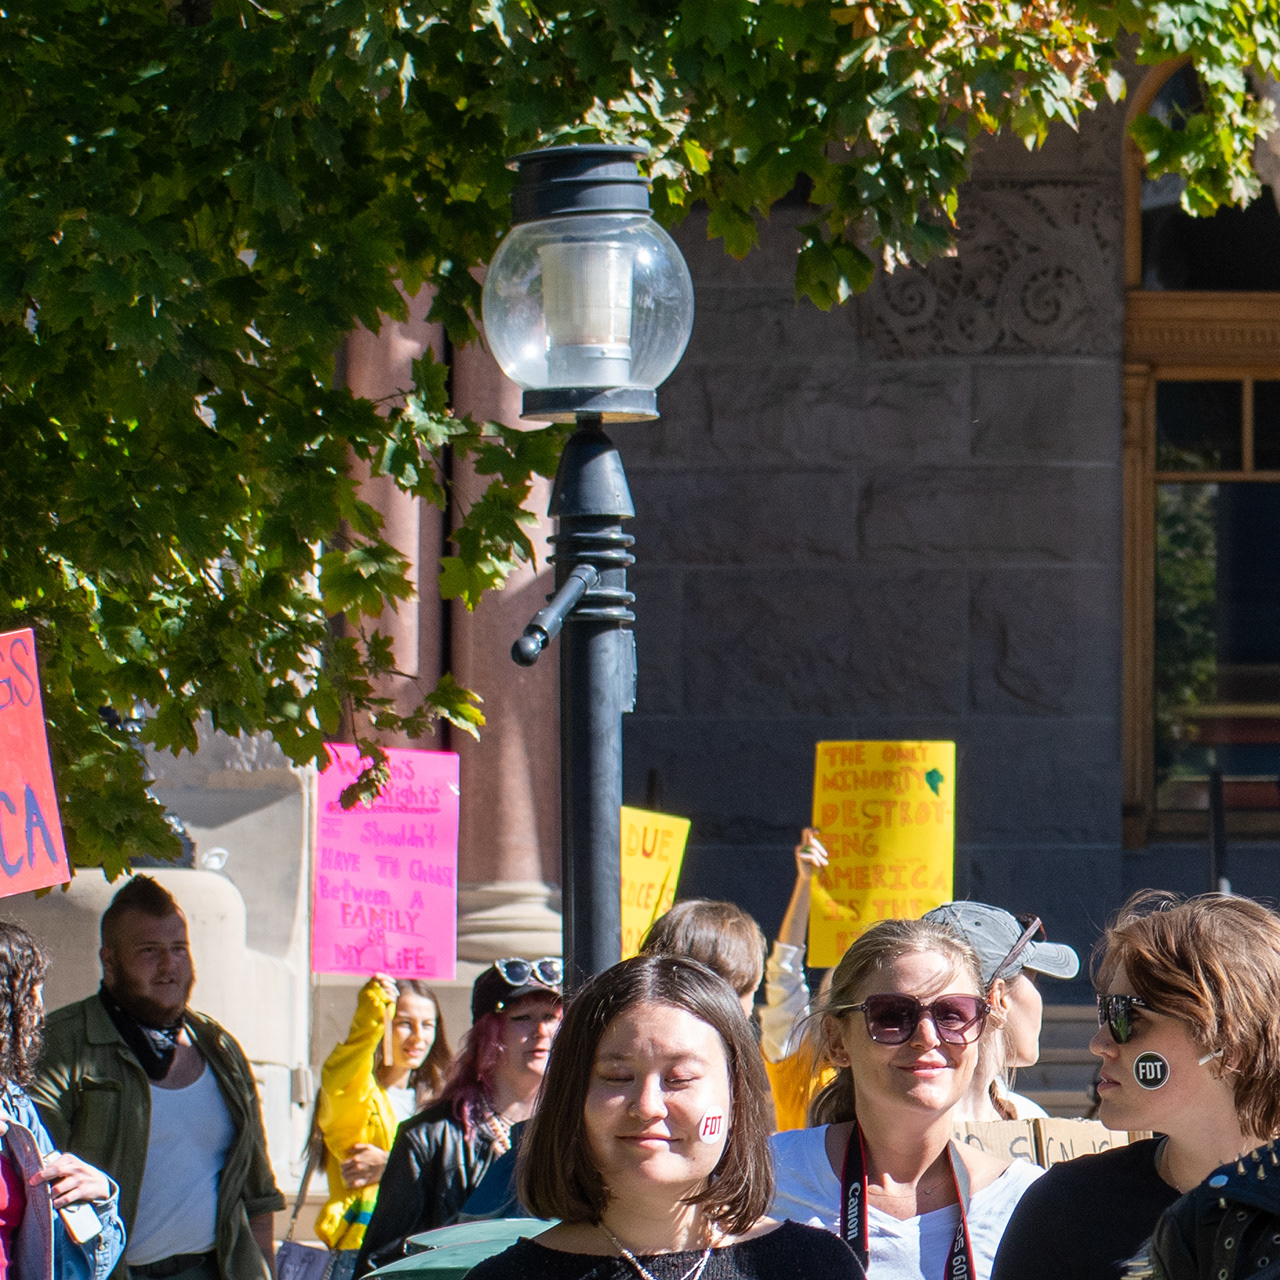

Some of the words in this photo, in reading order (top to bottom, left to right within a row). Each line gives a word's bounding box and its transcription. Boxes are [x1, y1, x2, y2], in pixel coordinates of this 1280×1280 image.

[824, 744, 866, 768] THE
[625, 824, 673, 862] DUE
[321, 848, 361, 873] HAVE
[817, 864, 948, 891] AMERICA
[824, 899, 861, 922] IS
[334, 943, 367, 967] MY
[1138, 1061, 1163, 1080] FDT
[702, 1115, 722, 1136] FDT
[848, 1181, 862, 1241] Canon
[954, 1217, 965, 1254] OS
